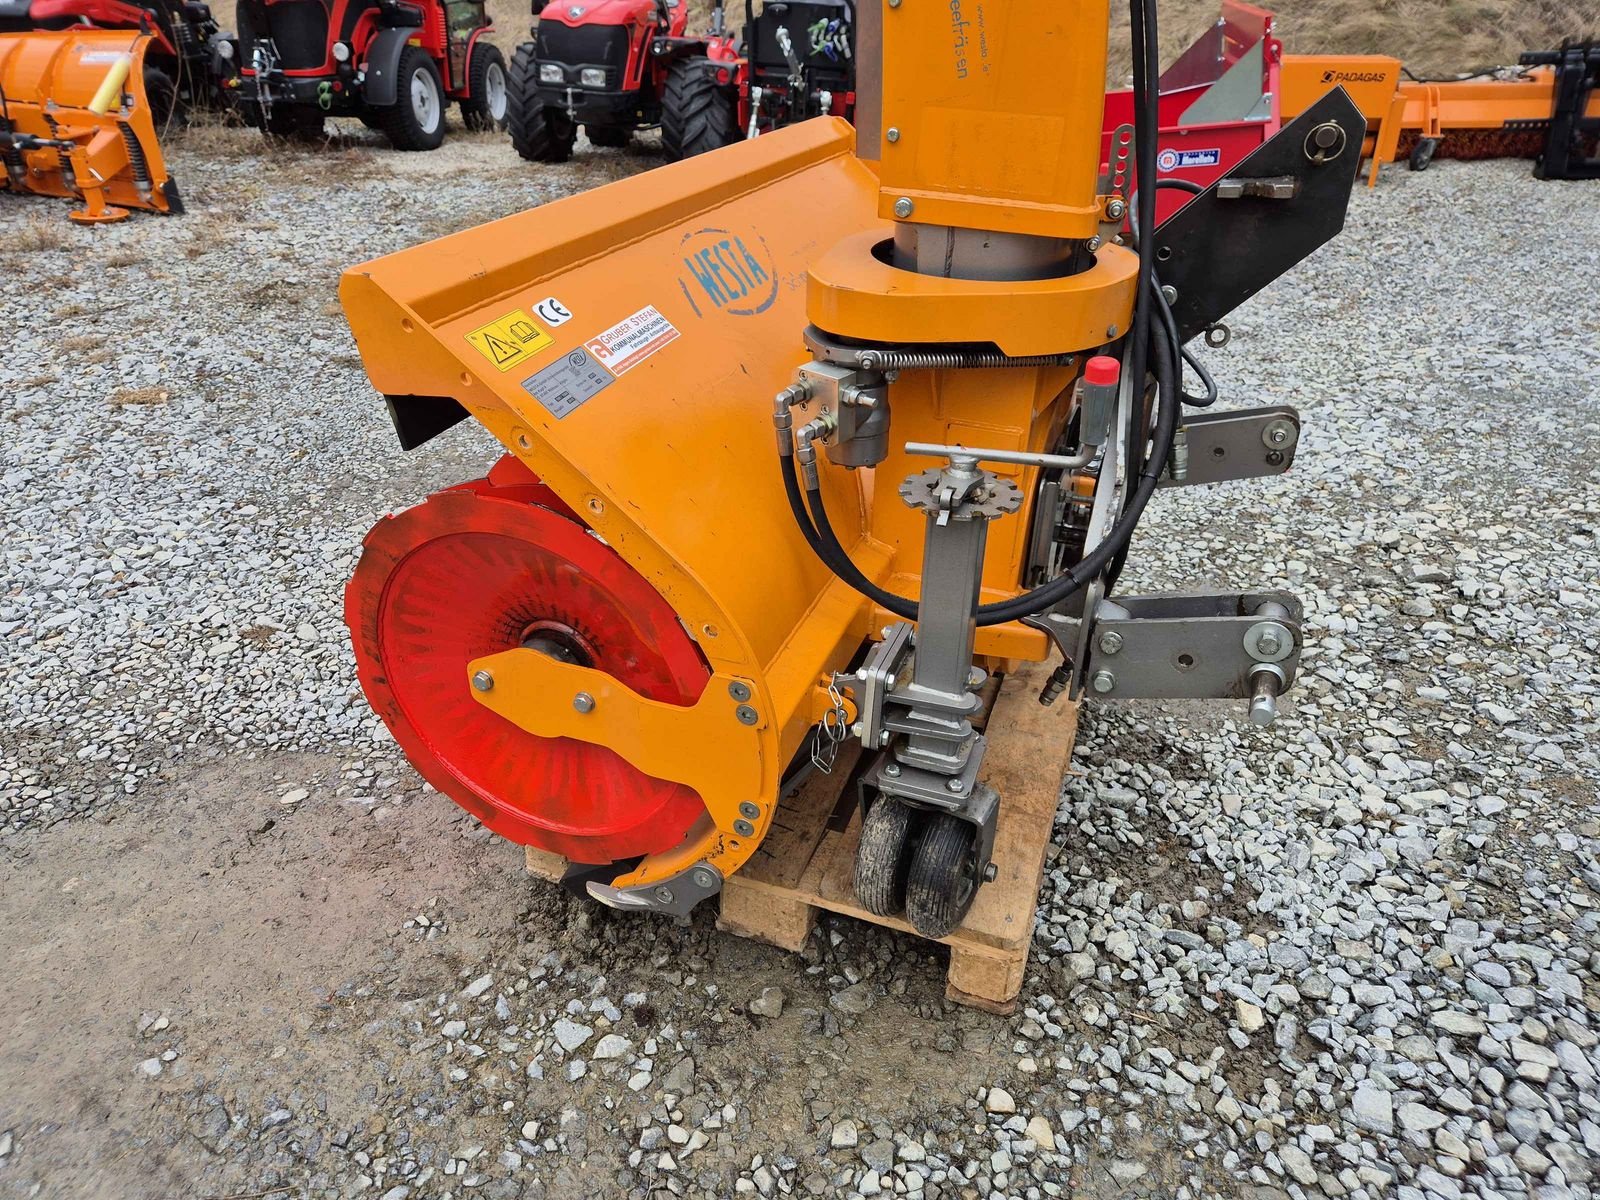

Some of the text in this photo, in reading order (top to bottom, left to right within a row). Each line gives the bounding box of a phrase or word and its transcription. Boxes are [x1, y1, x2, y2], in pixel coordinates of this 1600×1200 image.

[1335, 72, 1386, 82] PADAGAS
[683, 235, 769, 308] WESTA
[538, 298, 571, 323] CE
[600, 308, 658, 345] GRUBER STEFAN
[610, 316, 666, 353] KOMMUNALMASCHINEN
